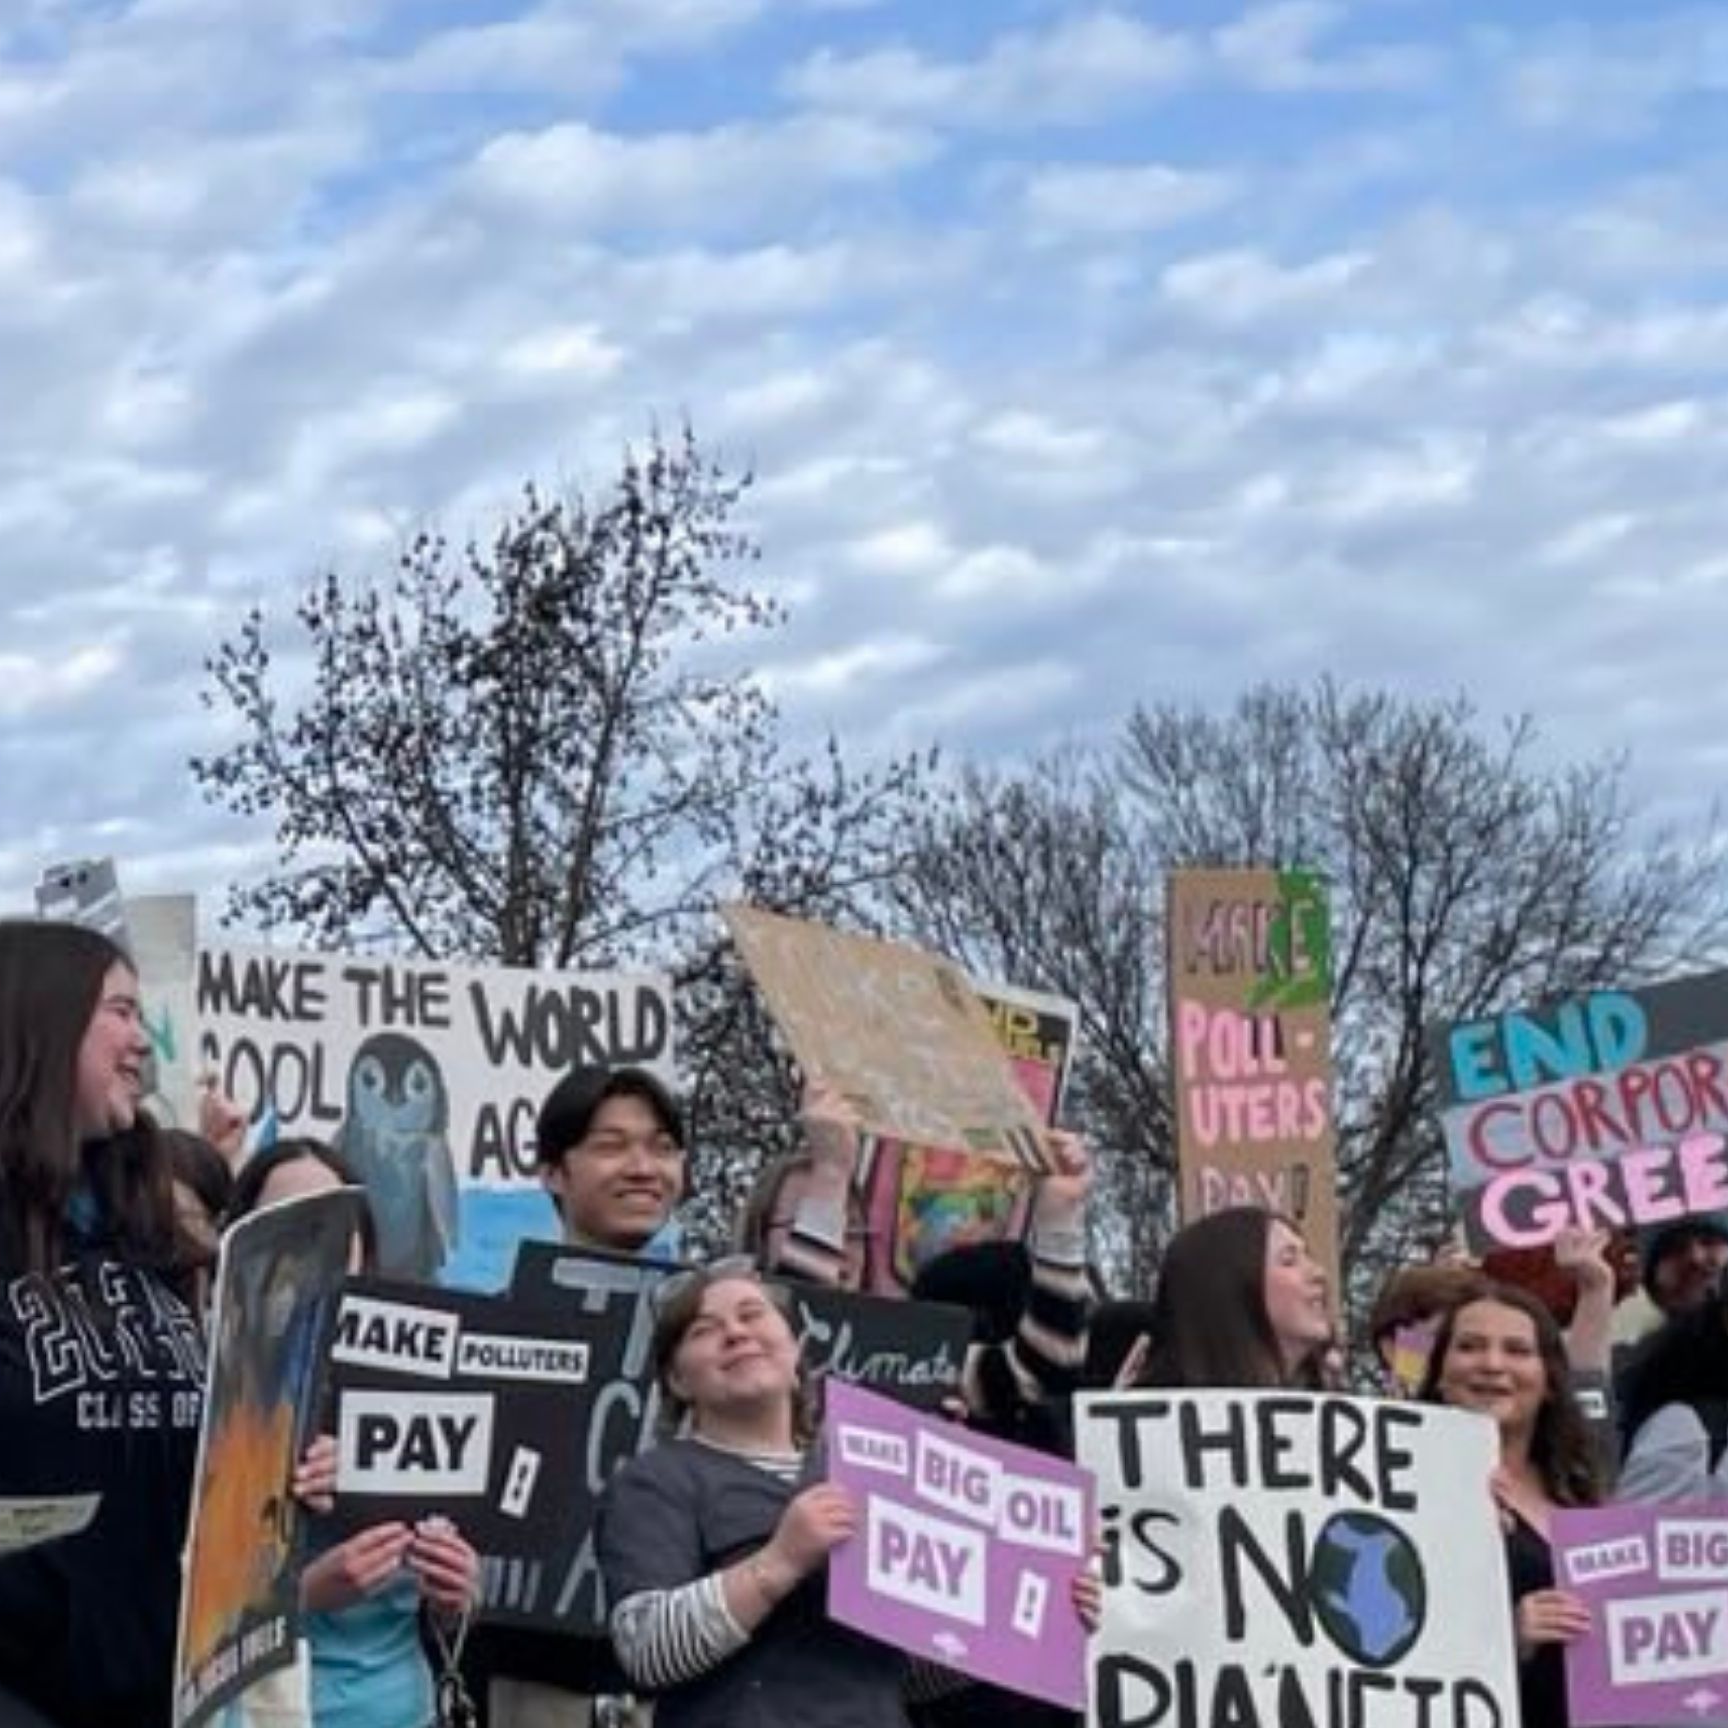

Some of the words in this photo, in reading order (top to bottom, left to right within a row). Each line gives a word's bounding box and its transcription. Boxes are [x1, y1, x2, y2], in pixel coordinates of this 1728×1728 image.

[197, 951, 327, 1022] MAKE
[342, 964, 450, 1028] THE
[469, 979, 668, 1070] WORLD
[1450, 990, 1648, 1100] END
[1190, 1078, 1327, 1145] UTERS
[463, 1341, 584, 1373] POLLUTERS
[355, 1413, 478, 1472] PAY
[1088, 1398, 1423, 1513] THERE
[923, 1448, 990, 1506] BIG
[1006, 1490, 1073, 1540] OIL
[879, 1520, 971, 1598] PAY
[1622, 1608, 1720, 1666] PAY
